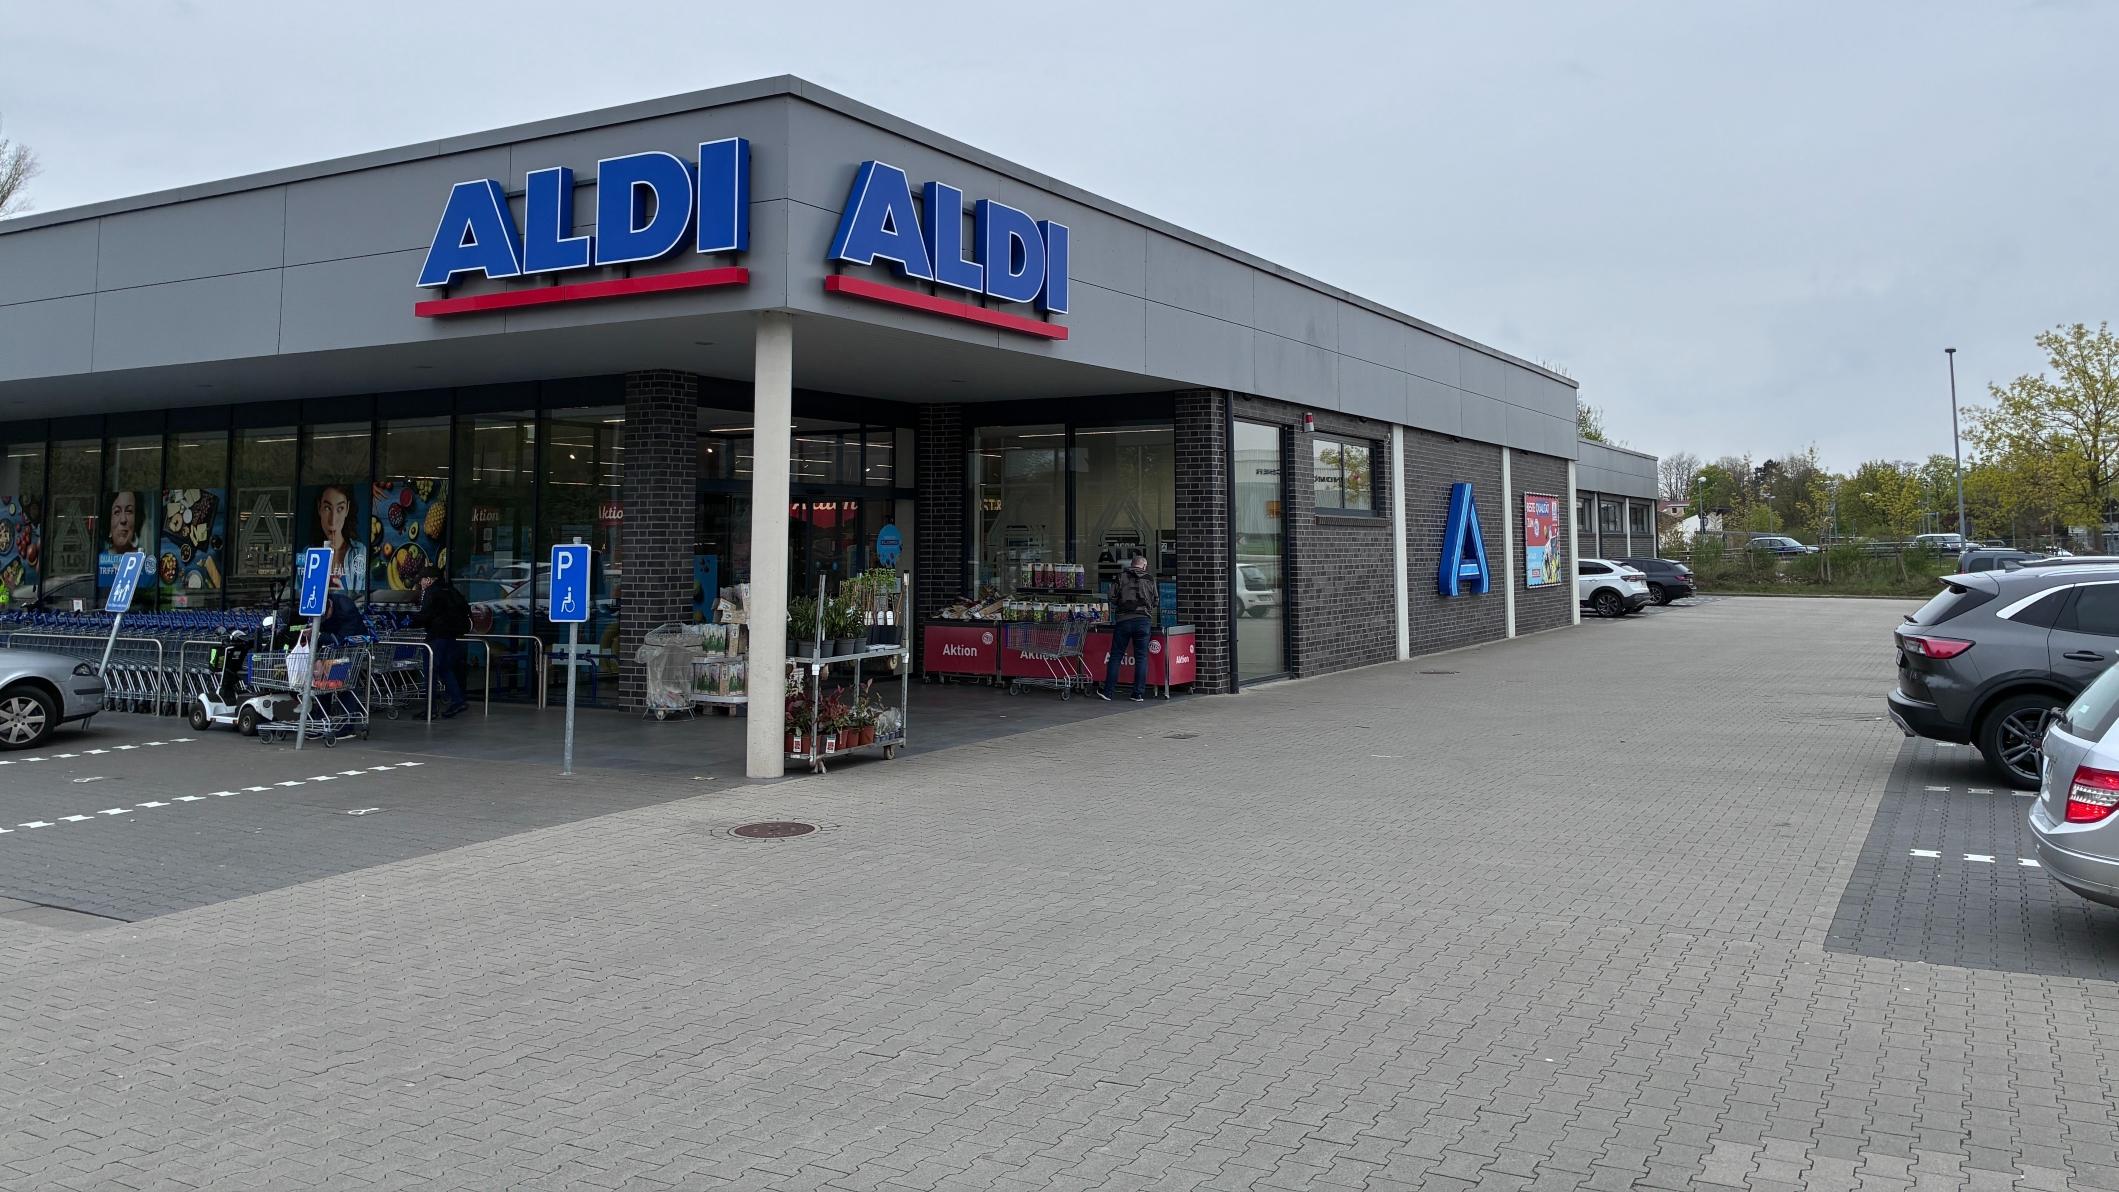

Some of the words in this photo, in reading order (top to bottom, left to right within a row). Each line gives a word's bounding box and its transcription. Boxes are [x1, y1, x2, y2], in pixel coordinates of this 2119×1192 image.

[416, 136, 748, 288] ALDI
[828, 159, 1070, 314] ALDI
[598, 504, 624, 519] ktio
[123, 556, 136, 578] P
[308, 553, 320, 579] P
[557, 551, 573, 579] P
[942, 643, 977, 658] Aktion
[1020, 649, 1058, 661] Akti
[1103, 651, 1136, 666] Atio
[1175, 654, 1190, 664] Aktion
